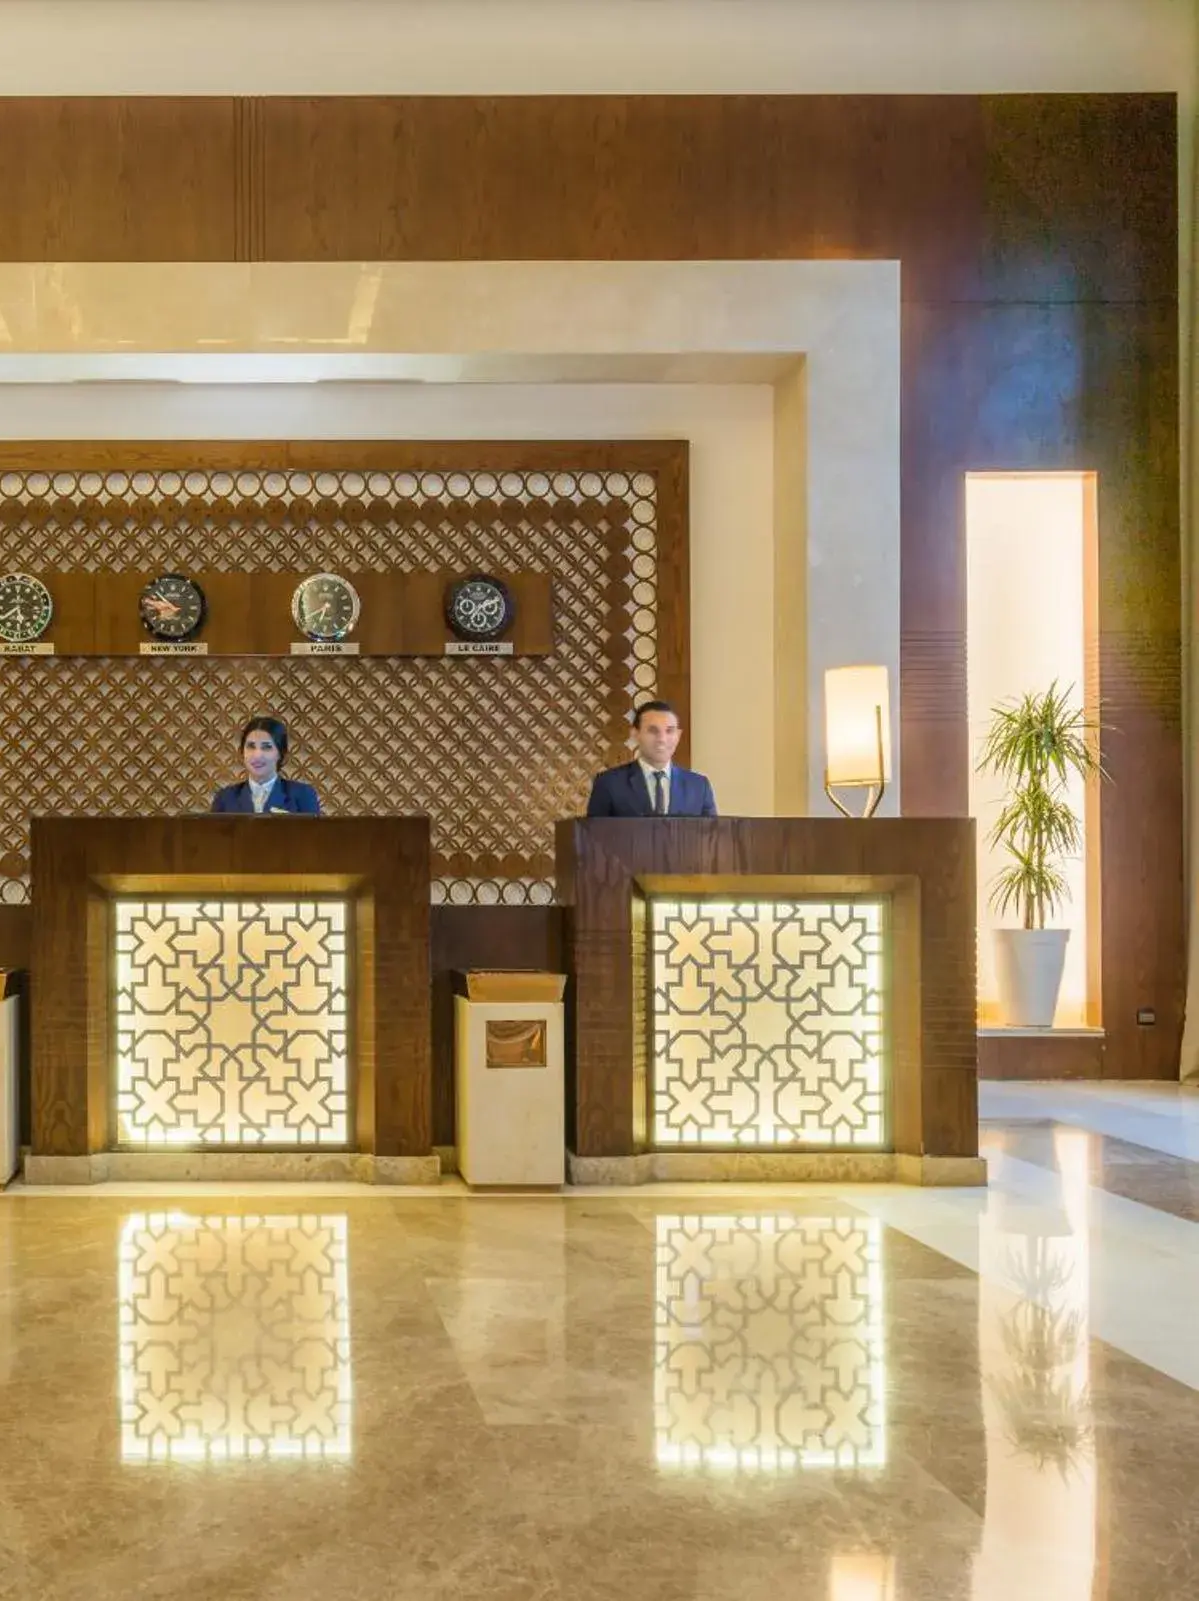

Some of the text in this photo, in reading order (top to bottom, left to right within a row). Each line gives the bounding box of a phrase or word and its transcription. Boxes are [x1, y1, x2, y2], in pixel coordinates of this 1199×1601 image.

[151, 645, 197, 653] NEW YORK
[310, 645, 342, 653] PARIS
[457, 645, 500, 653] LE CAIRE
